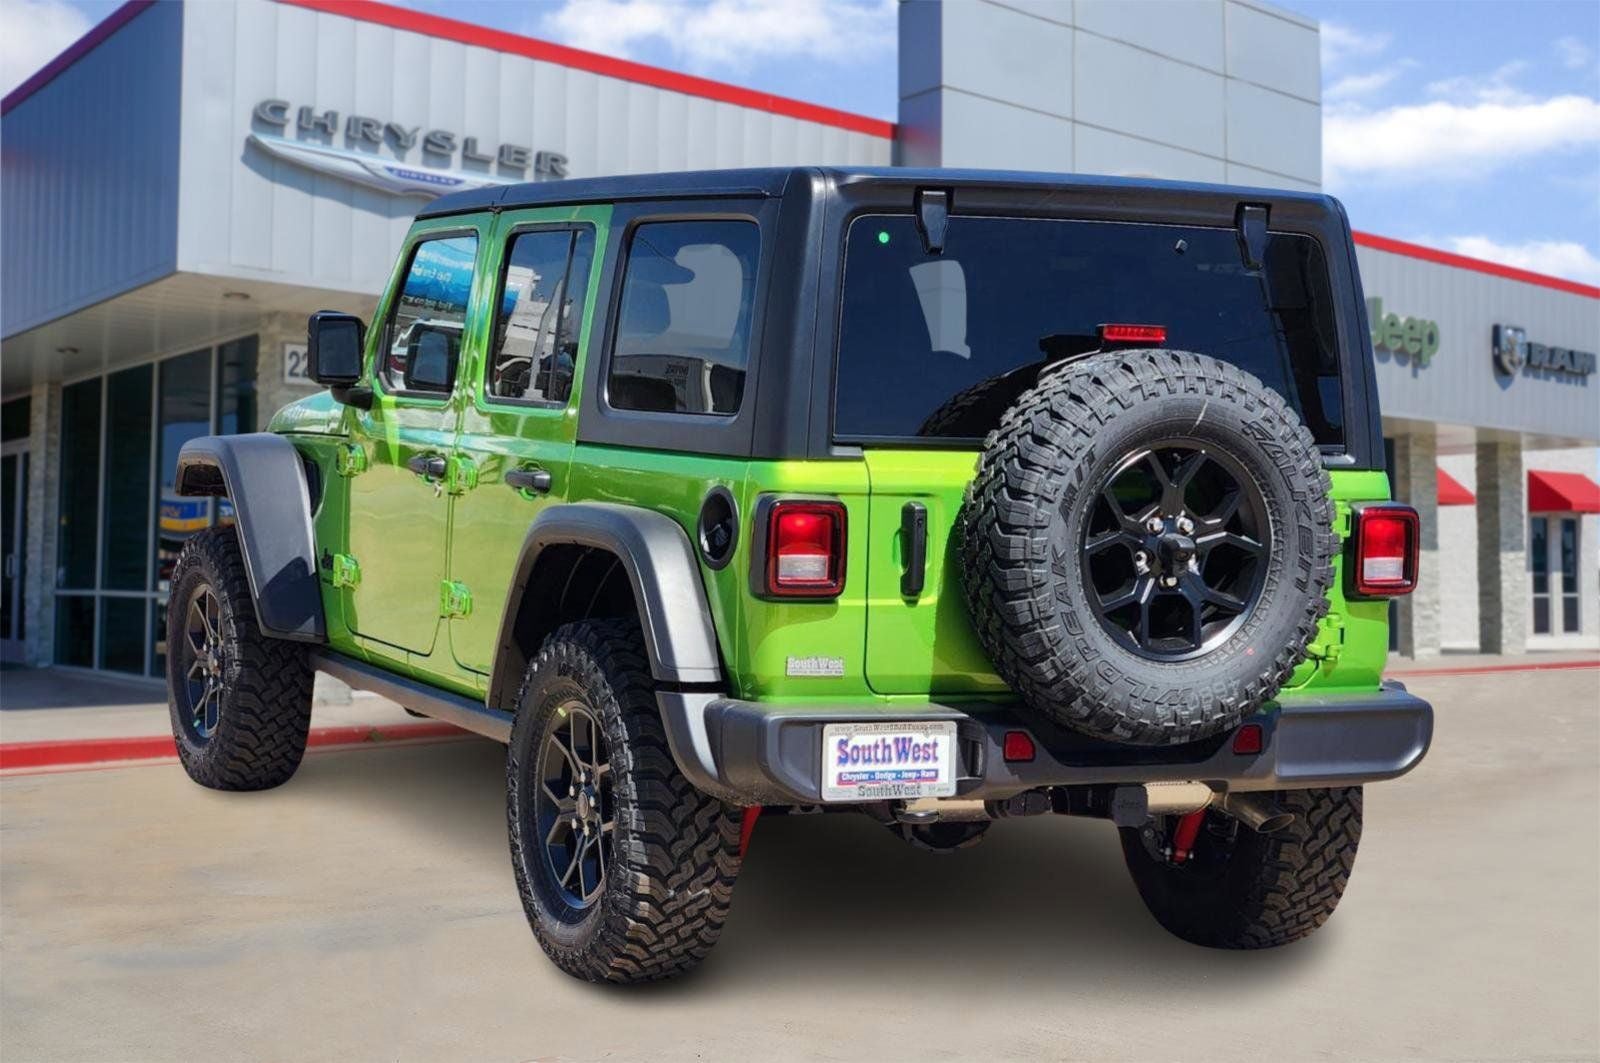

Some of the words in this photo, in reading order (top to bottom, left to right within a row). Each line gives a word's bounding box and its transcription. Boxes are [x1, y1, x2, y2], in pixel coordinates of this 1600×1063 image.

[252, 99, 570, 176] CHRYSLER
[1366, 296, 1440, 365] Jeep
[1526, 342, 1597, 375] RAM
